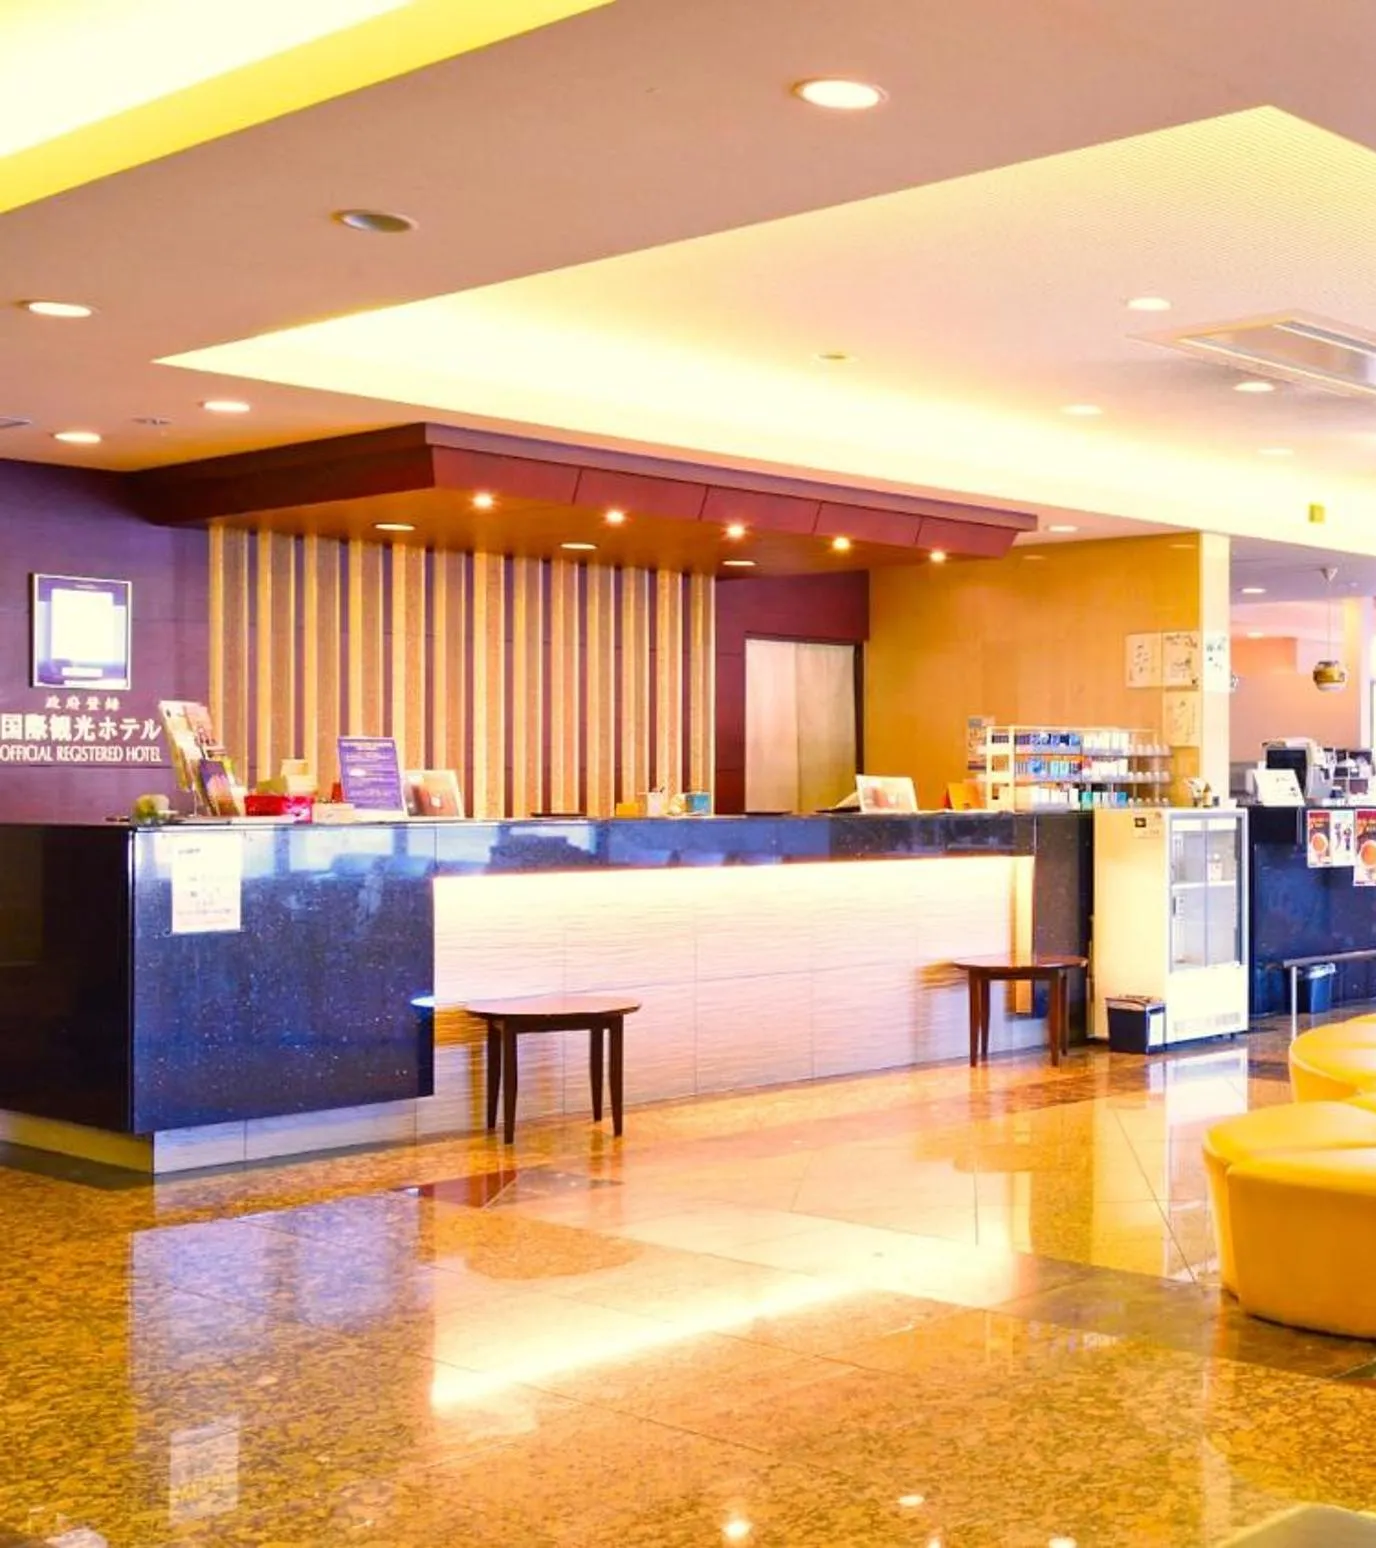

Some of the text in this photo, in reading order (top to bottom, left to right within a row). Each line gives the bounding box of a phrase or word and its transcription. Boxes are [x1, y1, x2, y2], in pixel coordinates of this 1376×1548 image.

[1, 713, 162, 741] 国際観光ホテル
[0, 745, 162, 762] OFFICIAL REGISTERED HOTEL
